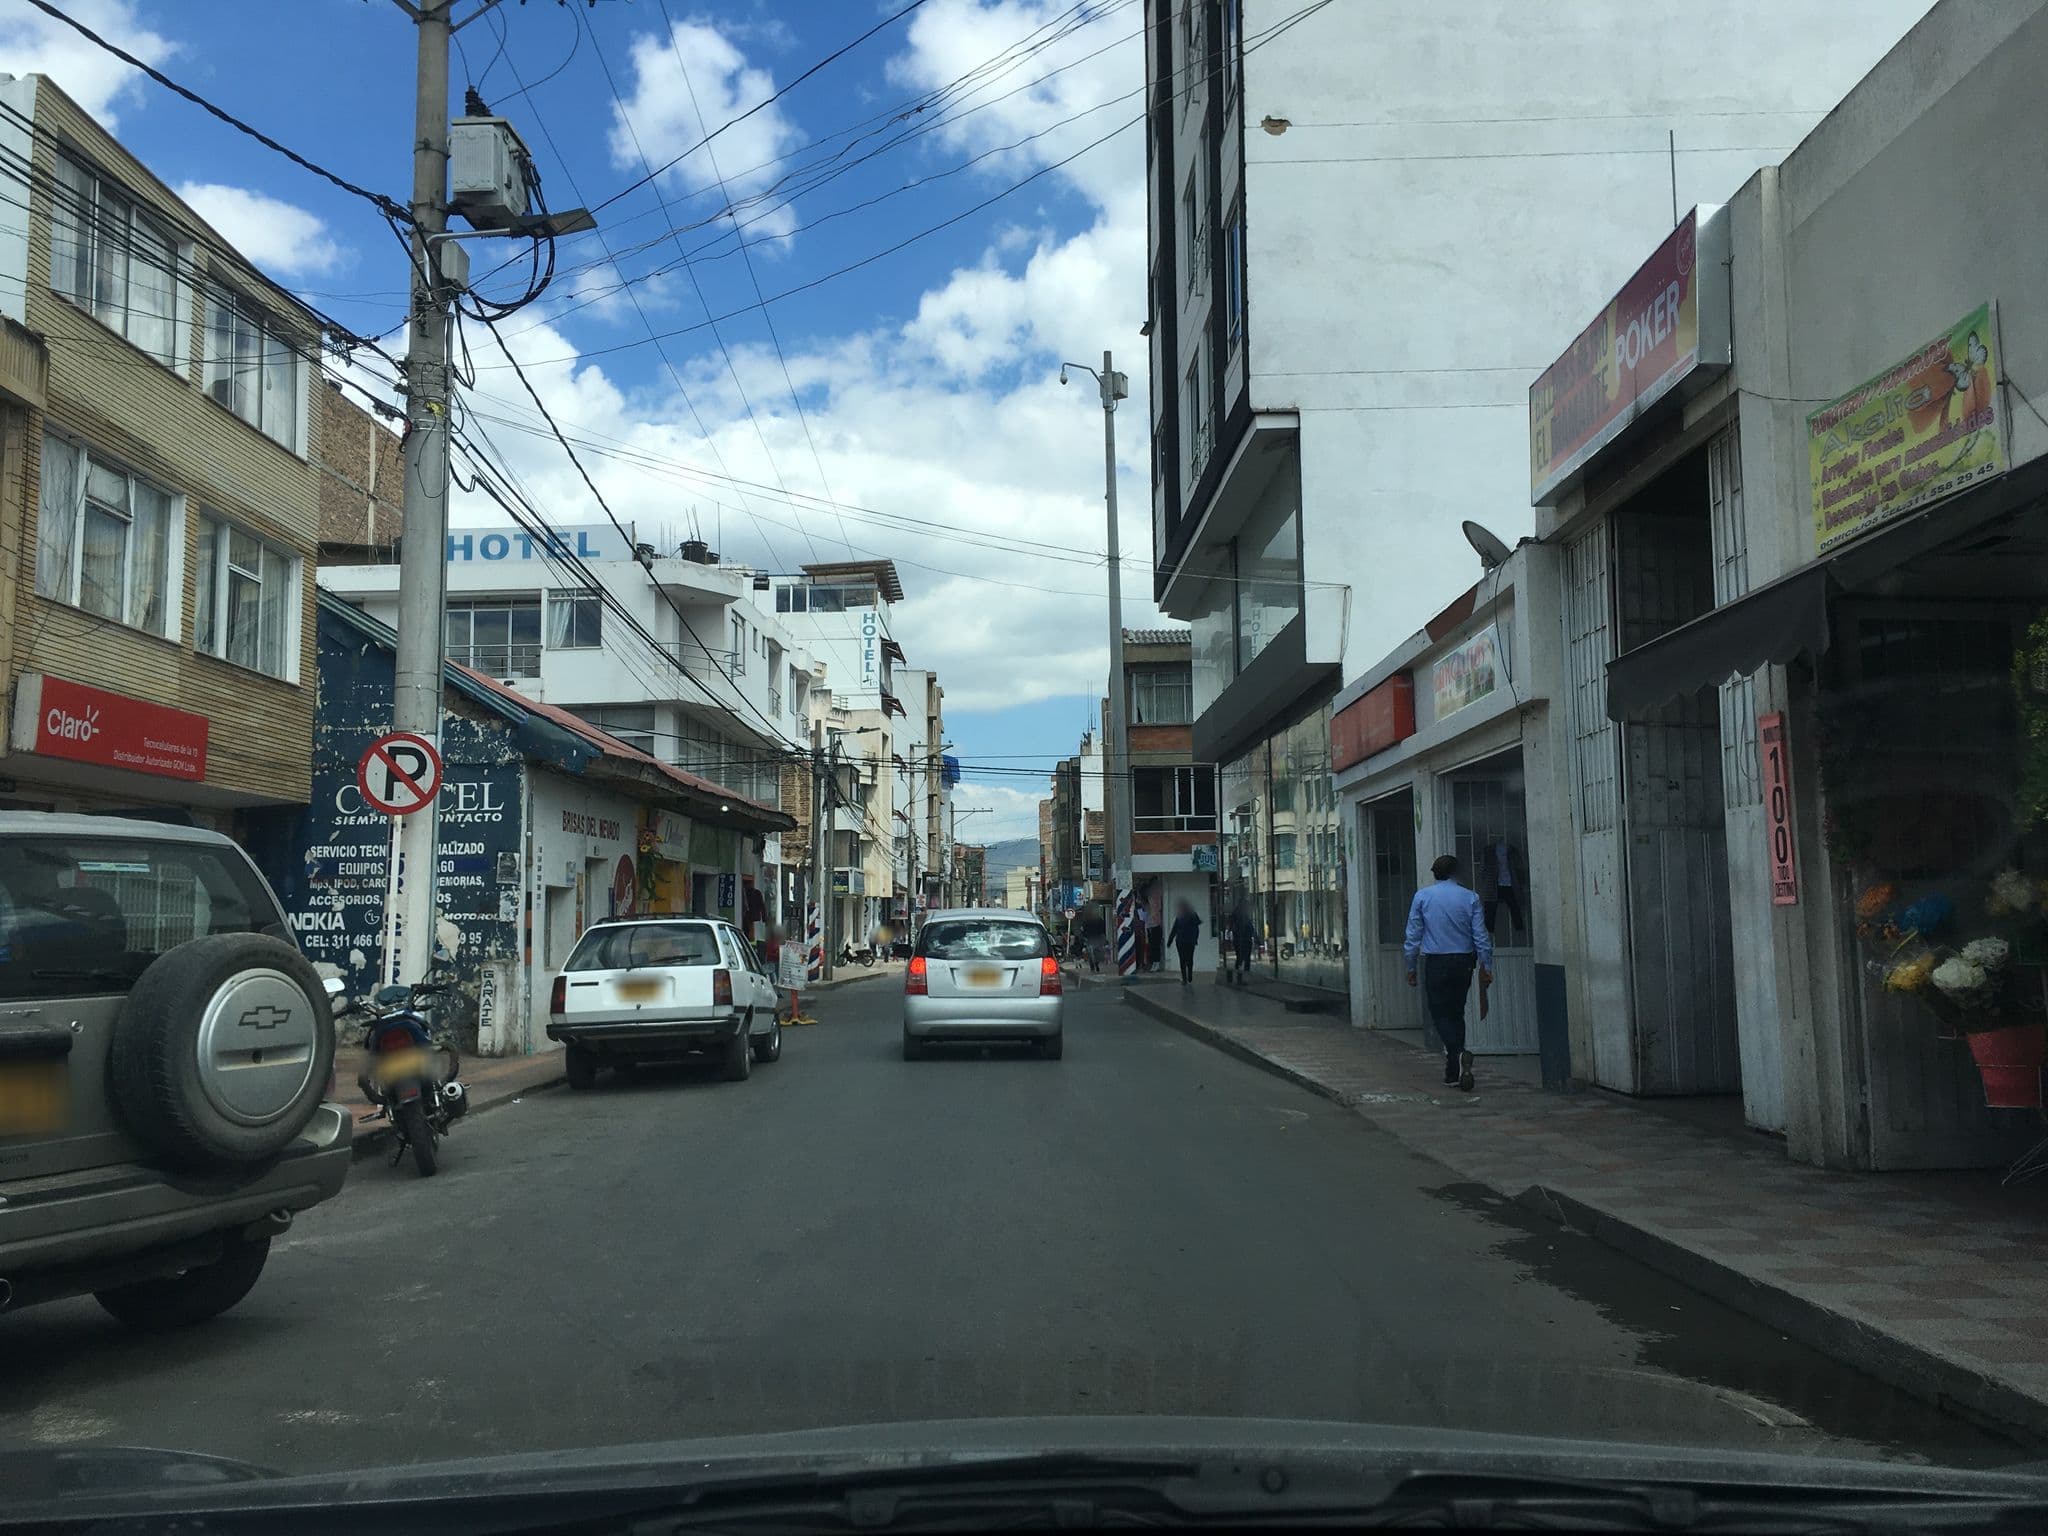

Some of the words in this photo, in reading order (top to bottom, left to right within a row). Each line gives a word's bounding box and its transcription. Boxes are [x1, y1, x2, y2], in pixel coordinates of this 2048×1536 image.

[1615, 280, 1680, 377] POKER
[1956, 472, 1973, 487] 29
[1976, 462, 1994, 476] 45
[448, 531, 601, 562] HOTEL
[863, 613, 876, 673] HOTEL
[47, 707, 92, 742] Claro
[1769, 747, 1788, 865] 100
[334, 815, 388, 826] SIEMPR
[562, 810, 585, 835] BRISAS
[586, 816, 597, 838] DEL
[599, 818, 621, 842] NEVADO
[309, 845, 357, 858] SERVICIO
[360, 844, 387, 858] TECN
[338, 862, 385, 876] EQUIPOS
[437, 875, 485, 888] EMORIAS,
[289, 912, 346, 931] NOKIA
[305, 935, 329, 948] CEL:
[331, 934, 351, 948] 311
[353, 934, 373, 947] 466
[468, 932, 482, 944] 95
[481, 970, 495, 1027] GARAJE
